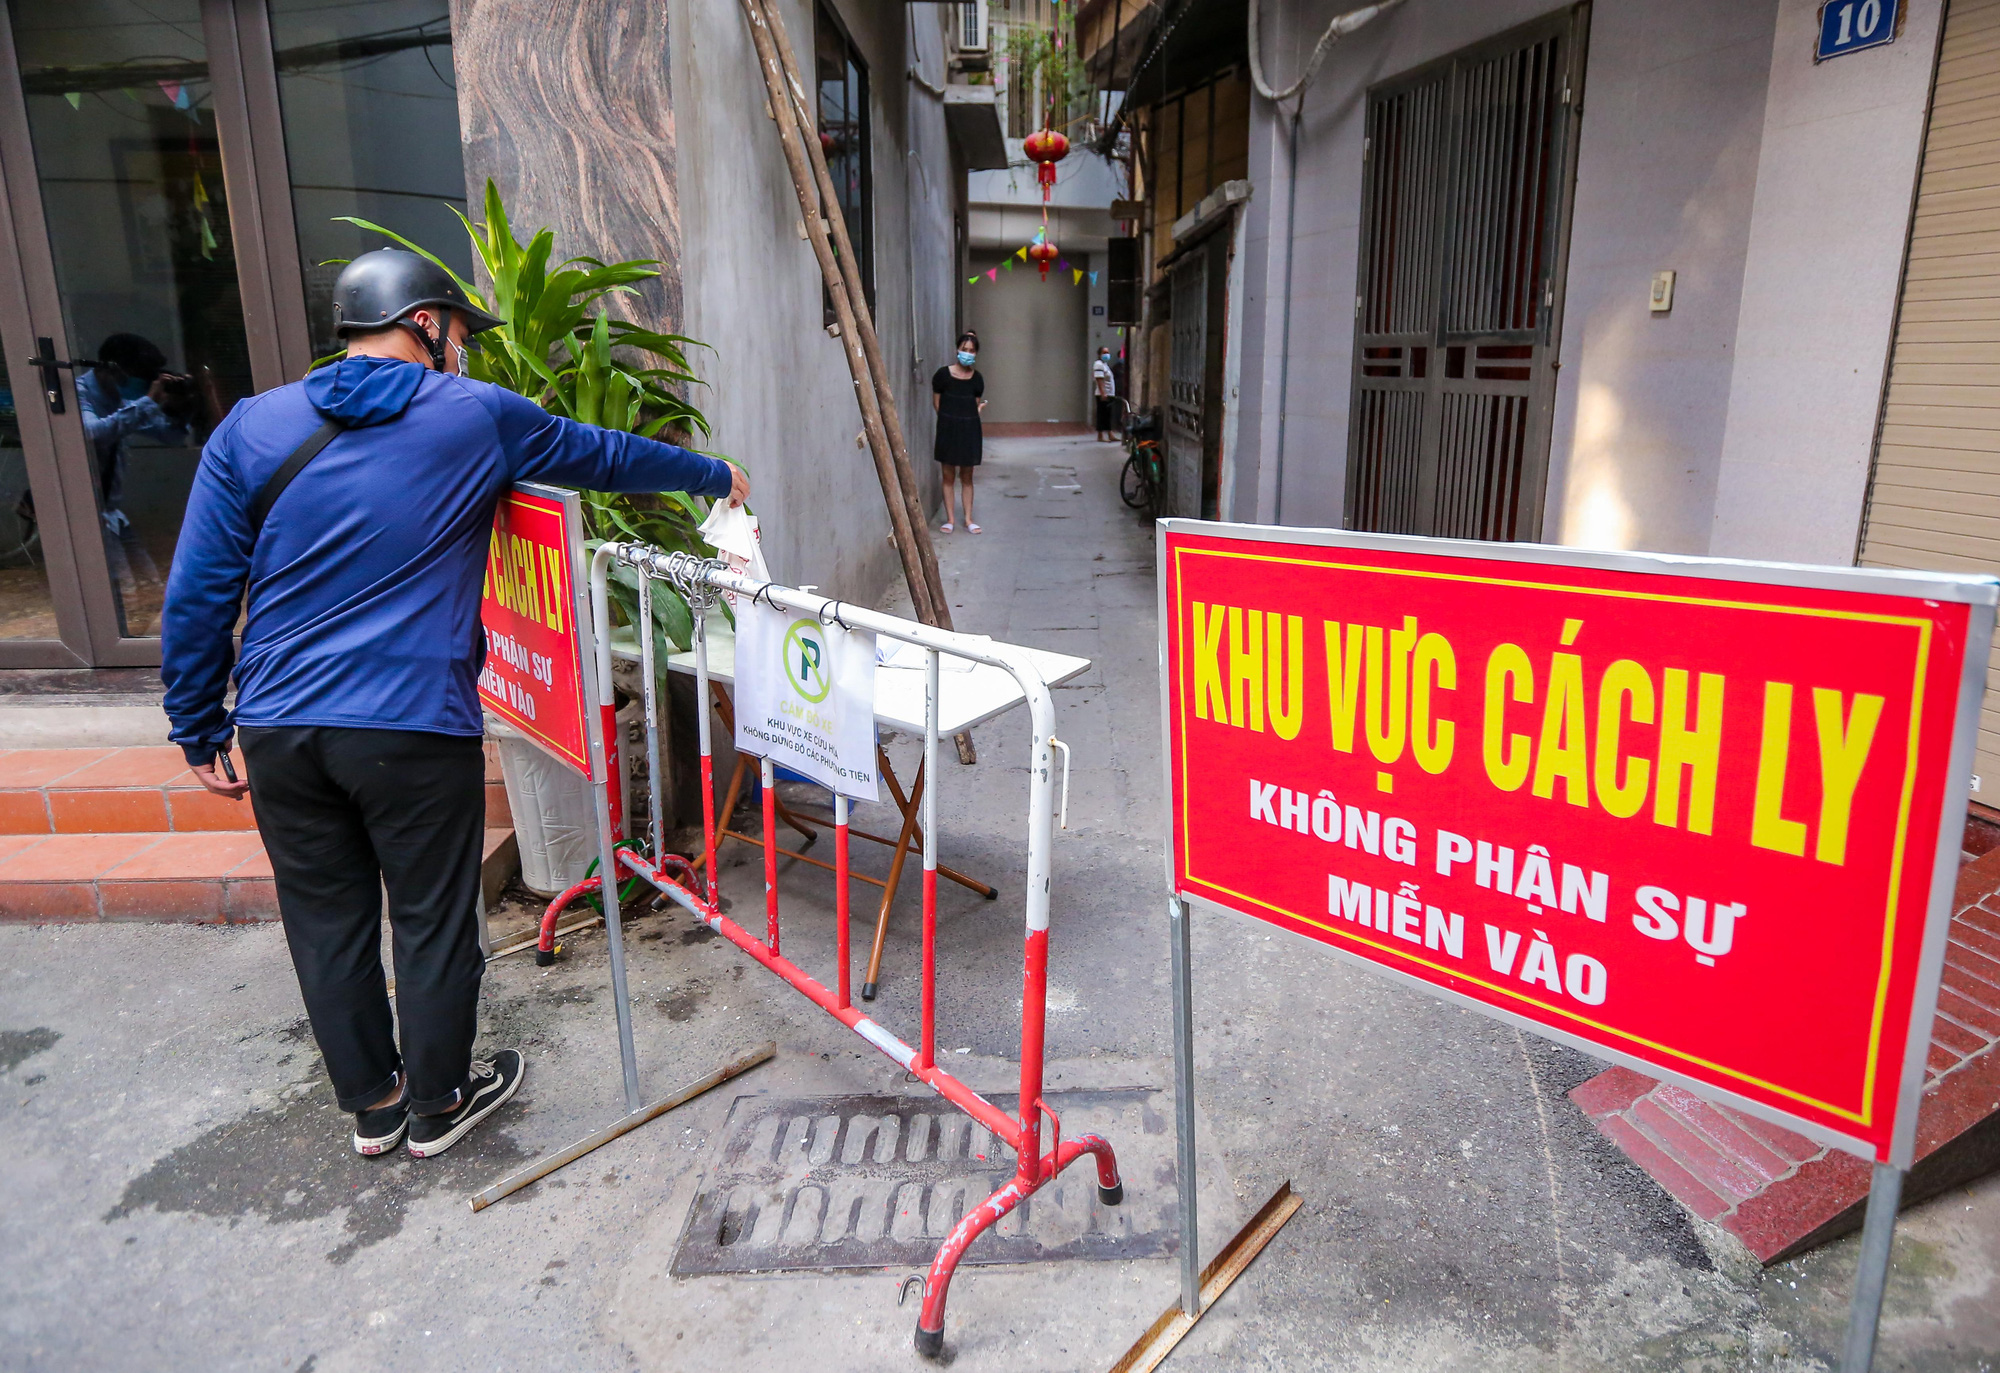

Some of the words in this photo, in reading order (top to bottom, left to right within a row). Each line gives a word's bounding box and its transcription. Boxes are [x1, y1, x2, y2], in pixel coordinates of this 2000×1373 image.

[1834, 0, 1881, 46] 10
[539, 543, 564, 635] LY
[491, 630, 530, 675] PHẬN
[532, 651, 553, 692] SỰ
[508, 683, 536, 721] VÀO
[767, 717, 786, 731] KHU
[787, 723, 802, 738] VỰC
[803, 730, 813, 743] XE
[821, 718, 833, 736] XE
[743, 725, 770, 741] KHÔNG
[806, 748, 820, 762] CÁC
[849, 769, 871, 784] TIỆN
[1192, 601, 1303, 741] KHU
[1323, 615, 1456, 794] VỰC
[1482, 618, 1725, 836] CÁCH
[1751, 681, 1885, 866] LY
[1250, 778, 1416, 866] KHÔNG
[1436, 829, 1609, 923] PHẬN
[1632, 885, 1747, 968] SỰ
[1328, 874, 1464, 959] MIỄN
[1484, 923, 1607, 1006] VÀO
